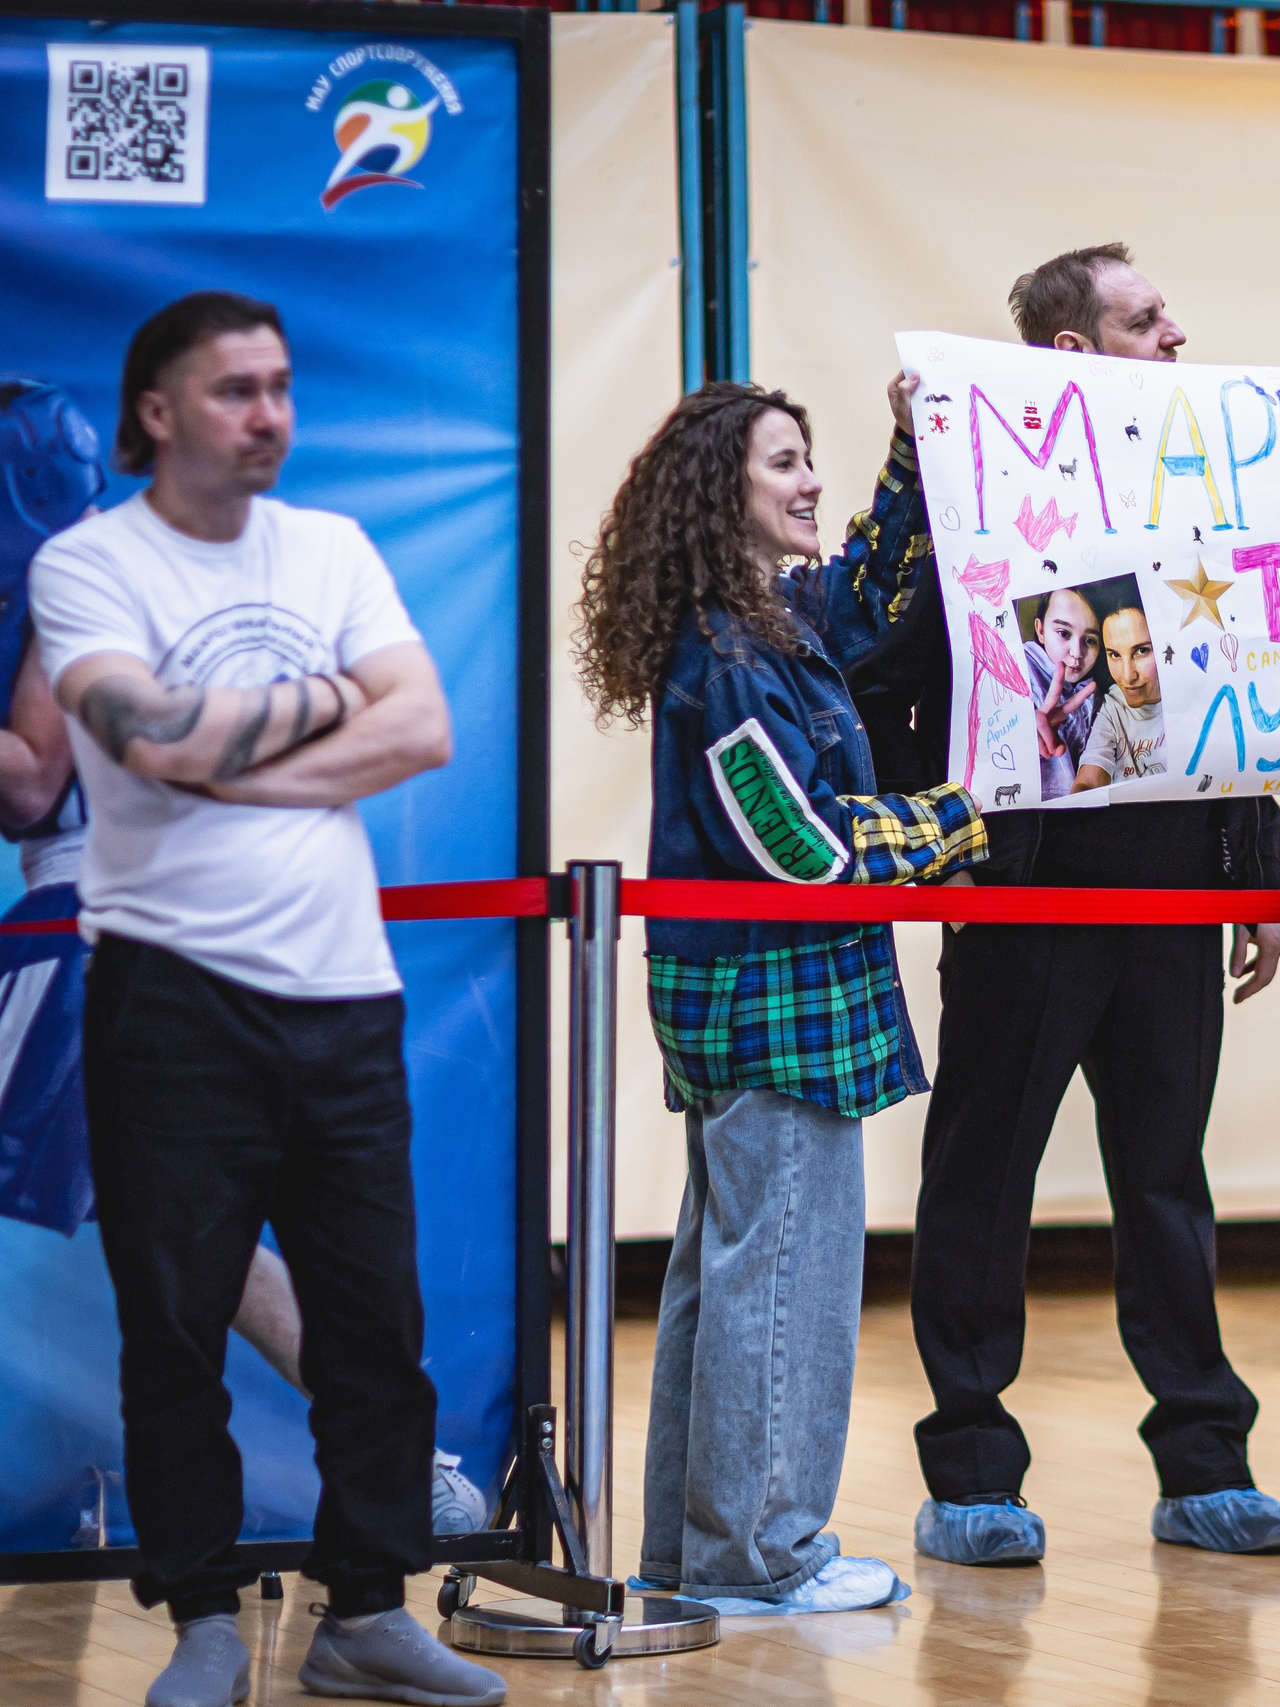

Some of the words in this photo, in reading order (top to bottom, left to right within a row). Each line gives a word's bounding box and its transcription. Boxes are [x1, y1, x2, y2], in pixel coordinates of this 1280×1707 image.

[304, 74, 331, 112] МАУ
[986, 714, 1019, 749] Арины
[762, 758, 783, 789] matter
[779, 790, 790, 801] no
[786, 801, 803, 816] you
[719, 740, 833, 880] FRIENDS
[794, 817, 809, 832] for
[806, 827, 825, 848] there
